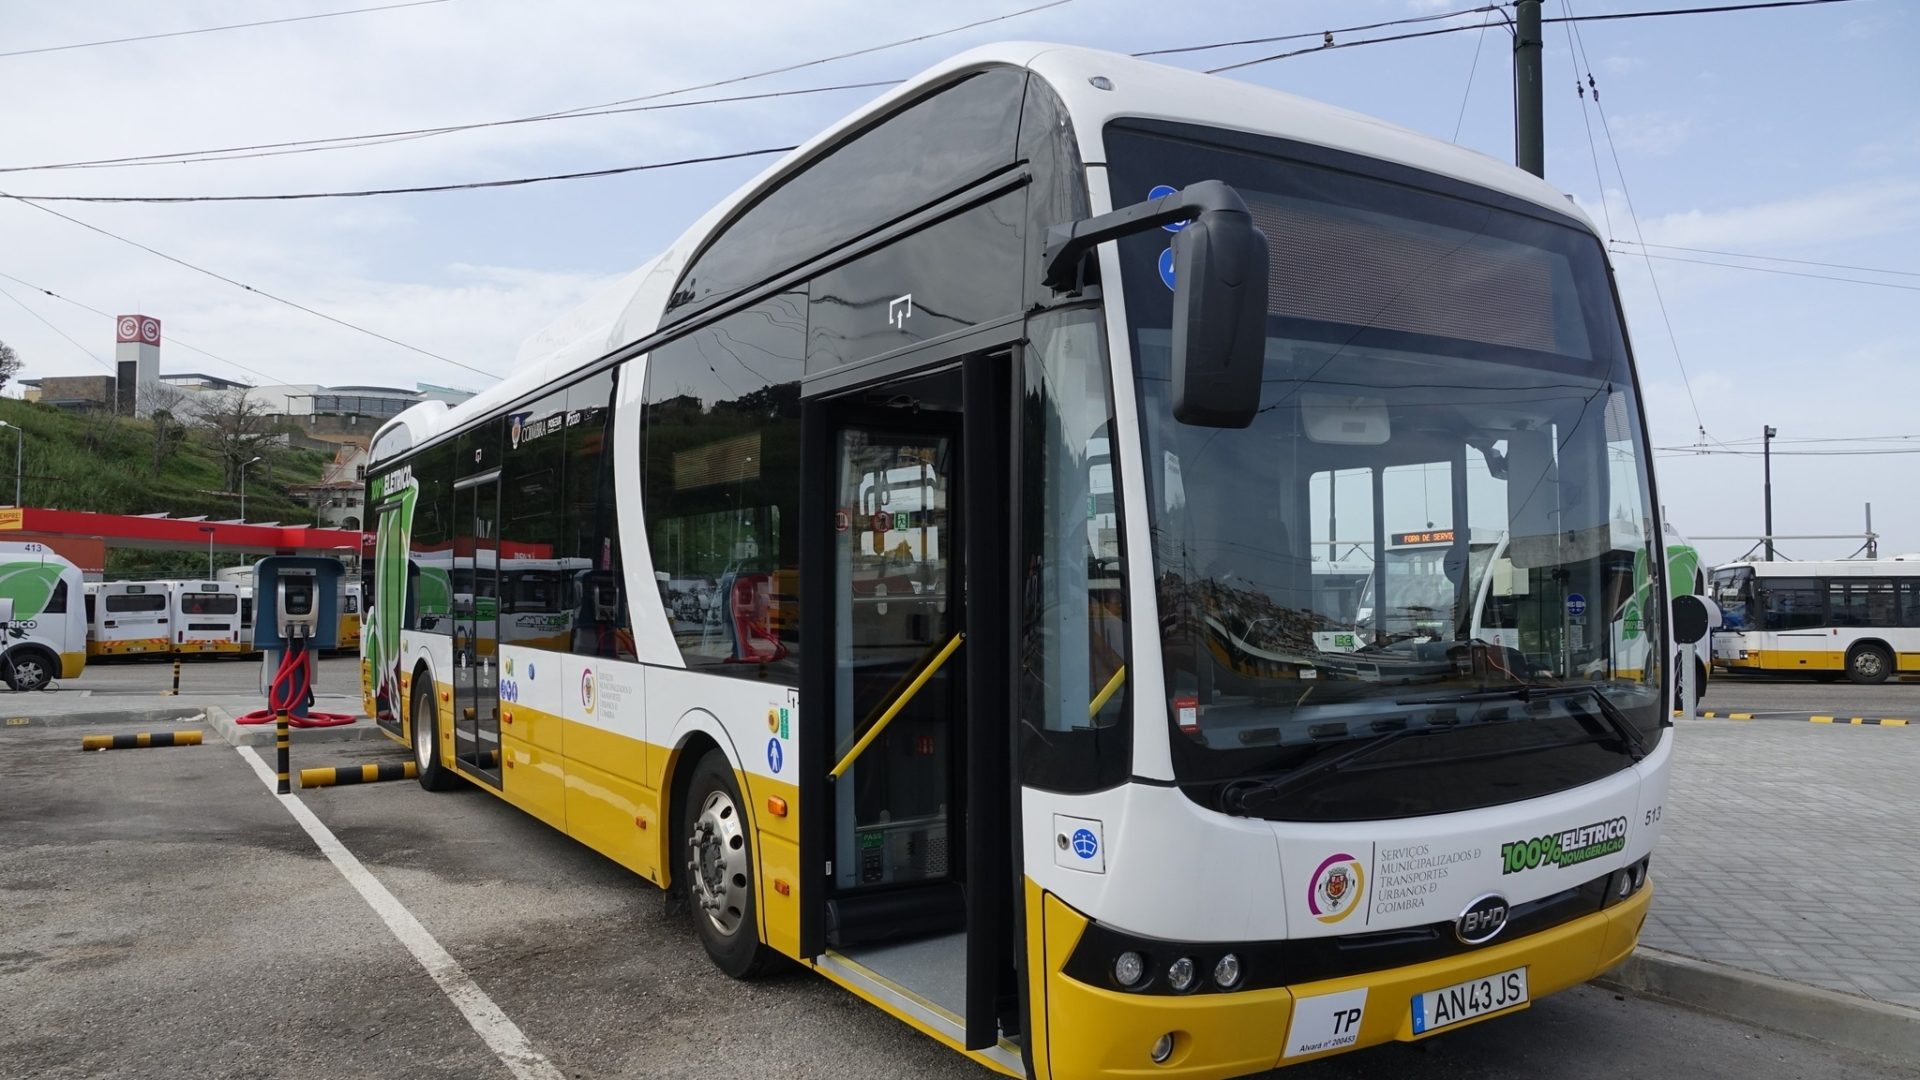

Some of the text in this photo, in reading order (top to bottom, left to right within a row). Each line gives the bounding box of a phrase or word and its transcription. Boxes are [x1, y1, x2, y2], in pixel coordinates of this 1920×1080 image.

[1404, 535, 1420, 544] FORA
[1422, 534, 1430, 542] DE
[25, 544, 42, 553] 413
[8, 620, 37, 630] RICO
[1644, 806, 1662, 826] 513
[1381, 844, 1429, 861] SERVIÇOS
[1502, 835, 1562, 874] 100%
[1381, 851, 1472, 875] MUNICIPALIZADOS
[1380, 868, 1448, 888] TRANSPORTES
[1378, 884, 1427, 901] URBANOS
[1376, 898, 1425, 914] COIMBRA
[1463, 906, 1505, 933] BYD
[1334, 1008, 1361, 1035] TP
[1415, 1017, 1422, 1026] P
